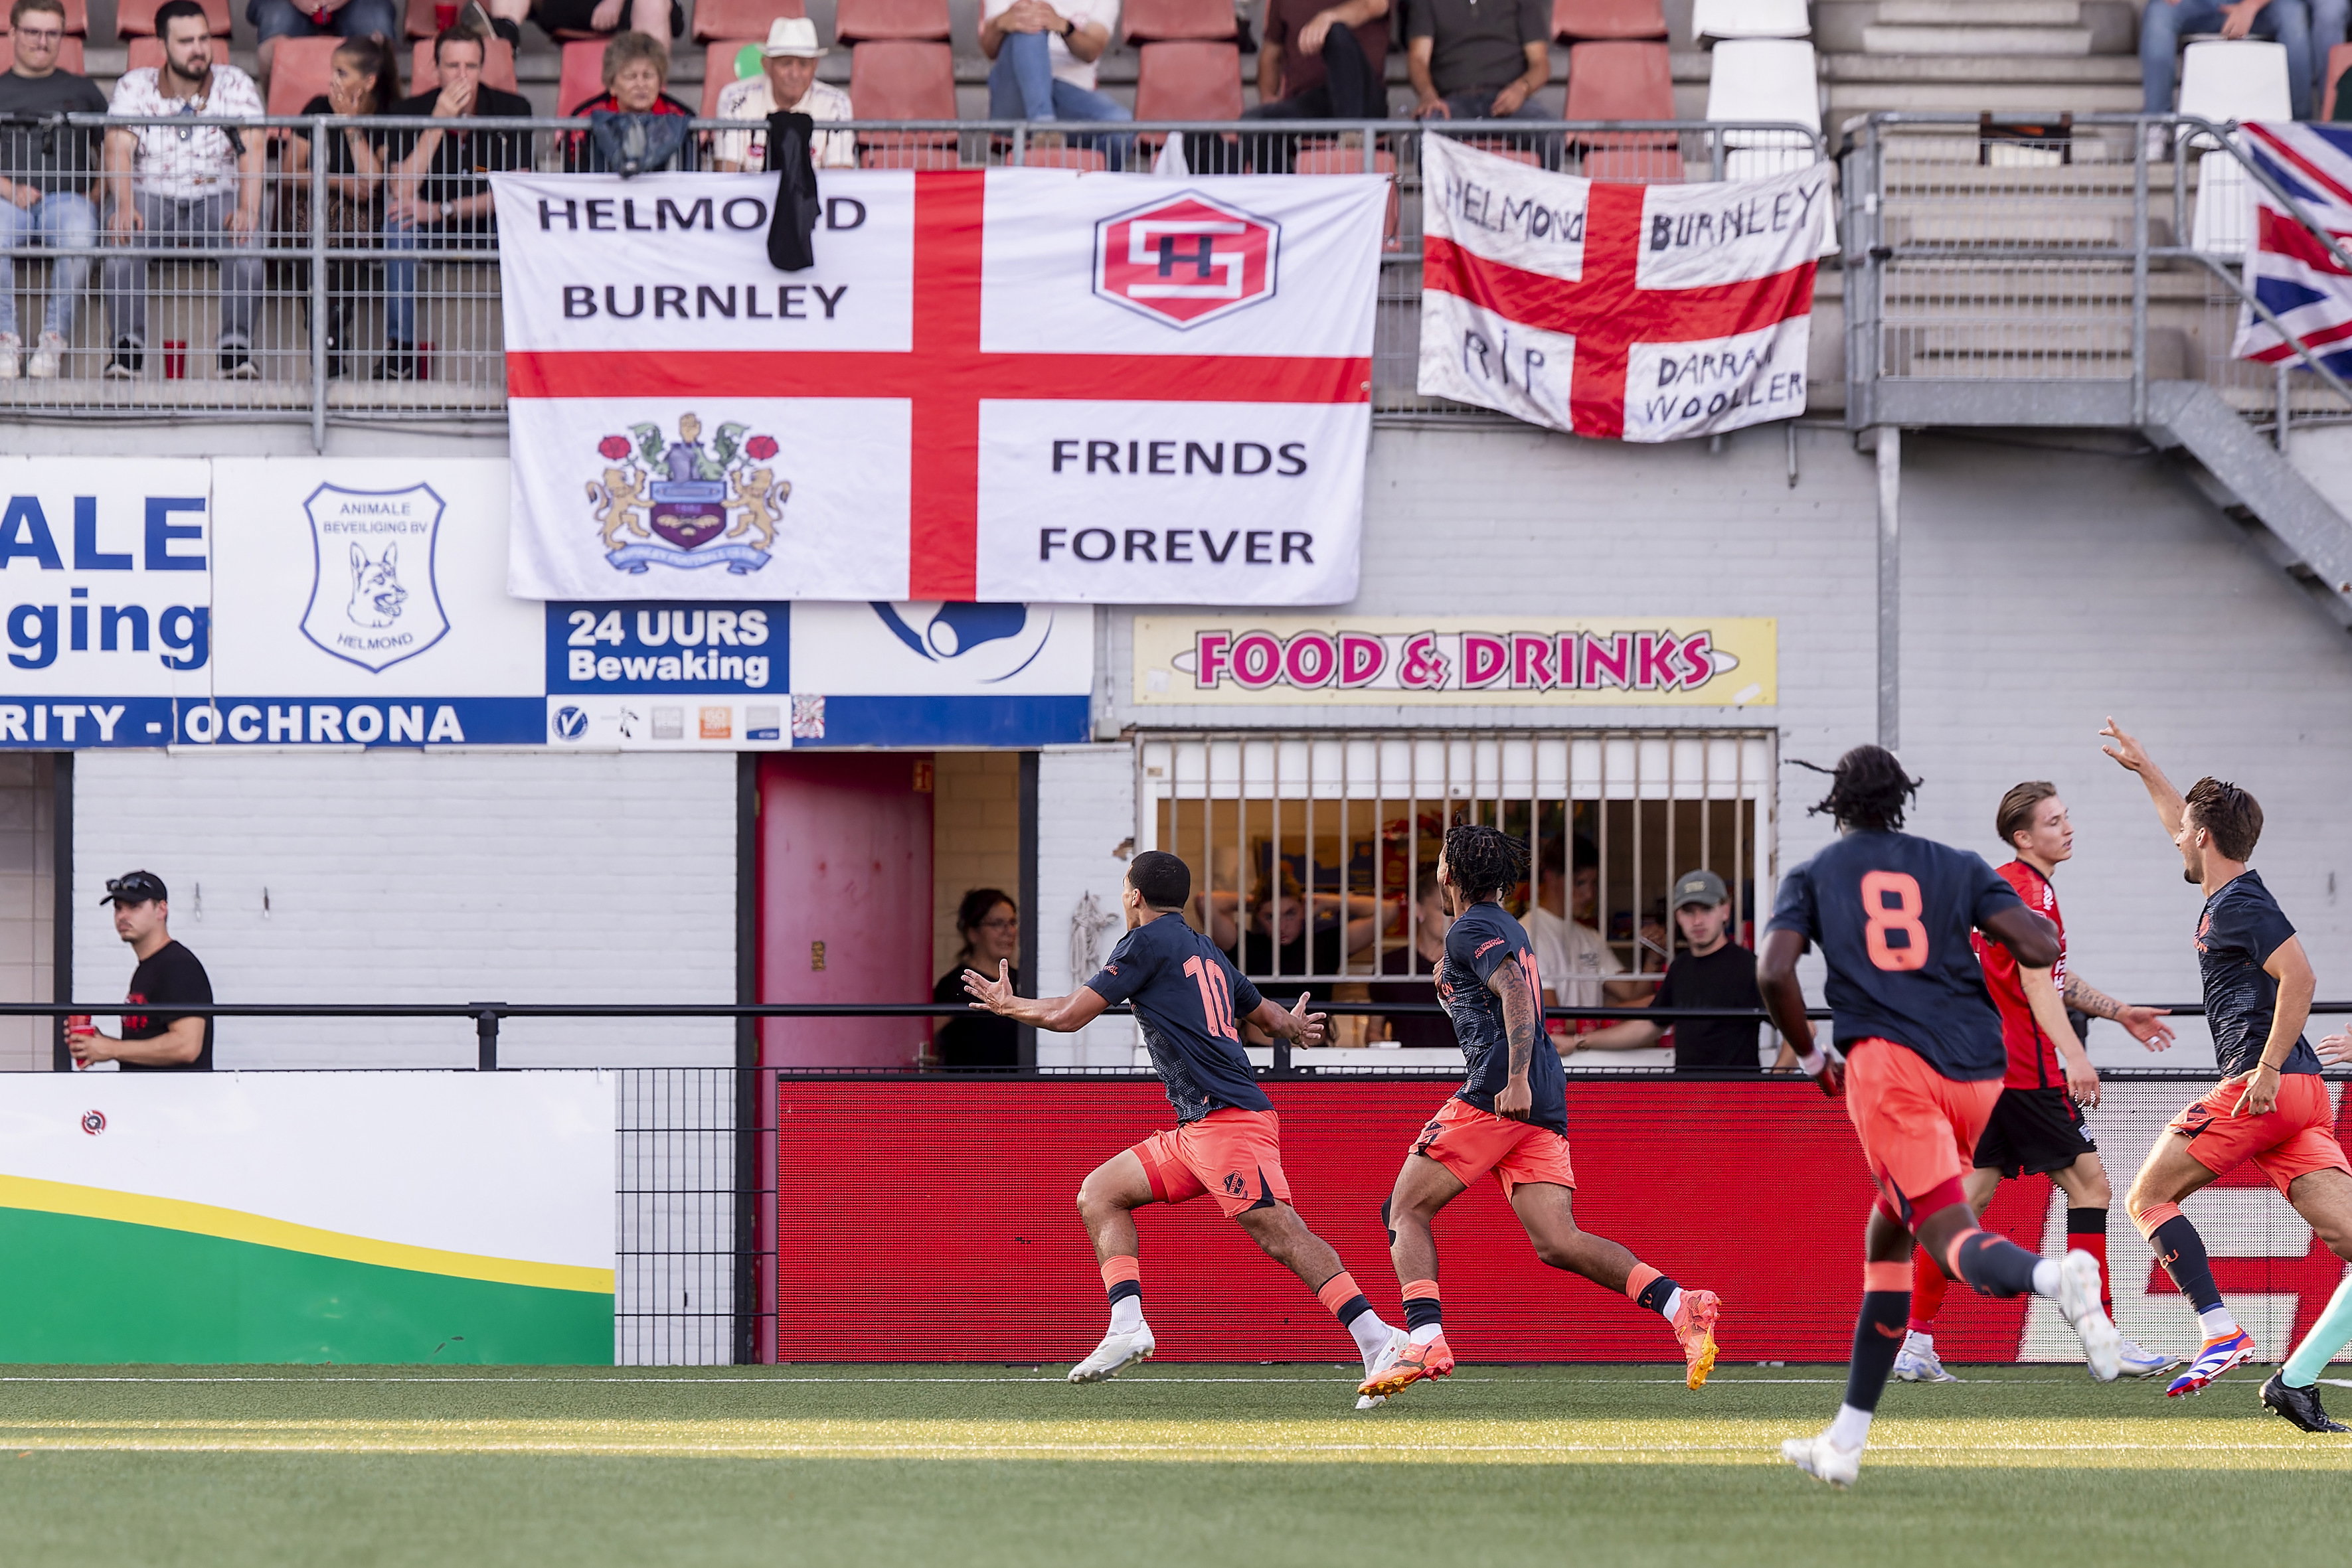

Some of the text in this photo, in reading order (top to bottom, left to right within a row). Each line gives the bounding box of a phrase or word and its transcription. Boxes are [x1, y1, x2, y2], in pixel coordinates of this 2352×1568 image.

[538, 196, 867, 232] HELMOD
[1649, 180, 1821, 252] BURNLEY
[563, 285, 849, 319] BURNLEY
[1052, 439, 1308, 477] FRIENDS
[323, 520, 428, 534] BEVEILIGING BV
[340, 502, 411, 516] ANIMALE
[0, 496, 207, 571] ALE
[1039, 527, 1314, 564] FOREVER
[7, 587, 209, 671] ging
[337, 633, 414, 650] HELMOND
[567, 610, 770, 647] 24 UURS
[568, 649, 770, 688] Bewaking
[1198, 632, 1713, 688] FOOD & DRINKS
[184, 704, 465, 743] OCHRONA
[1861, 870, 1929, 971] 8
[1183, 955, 1240, 1044] 10
